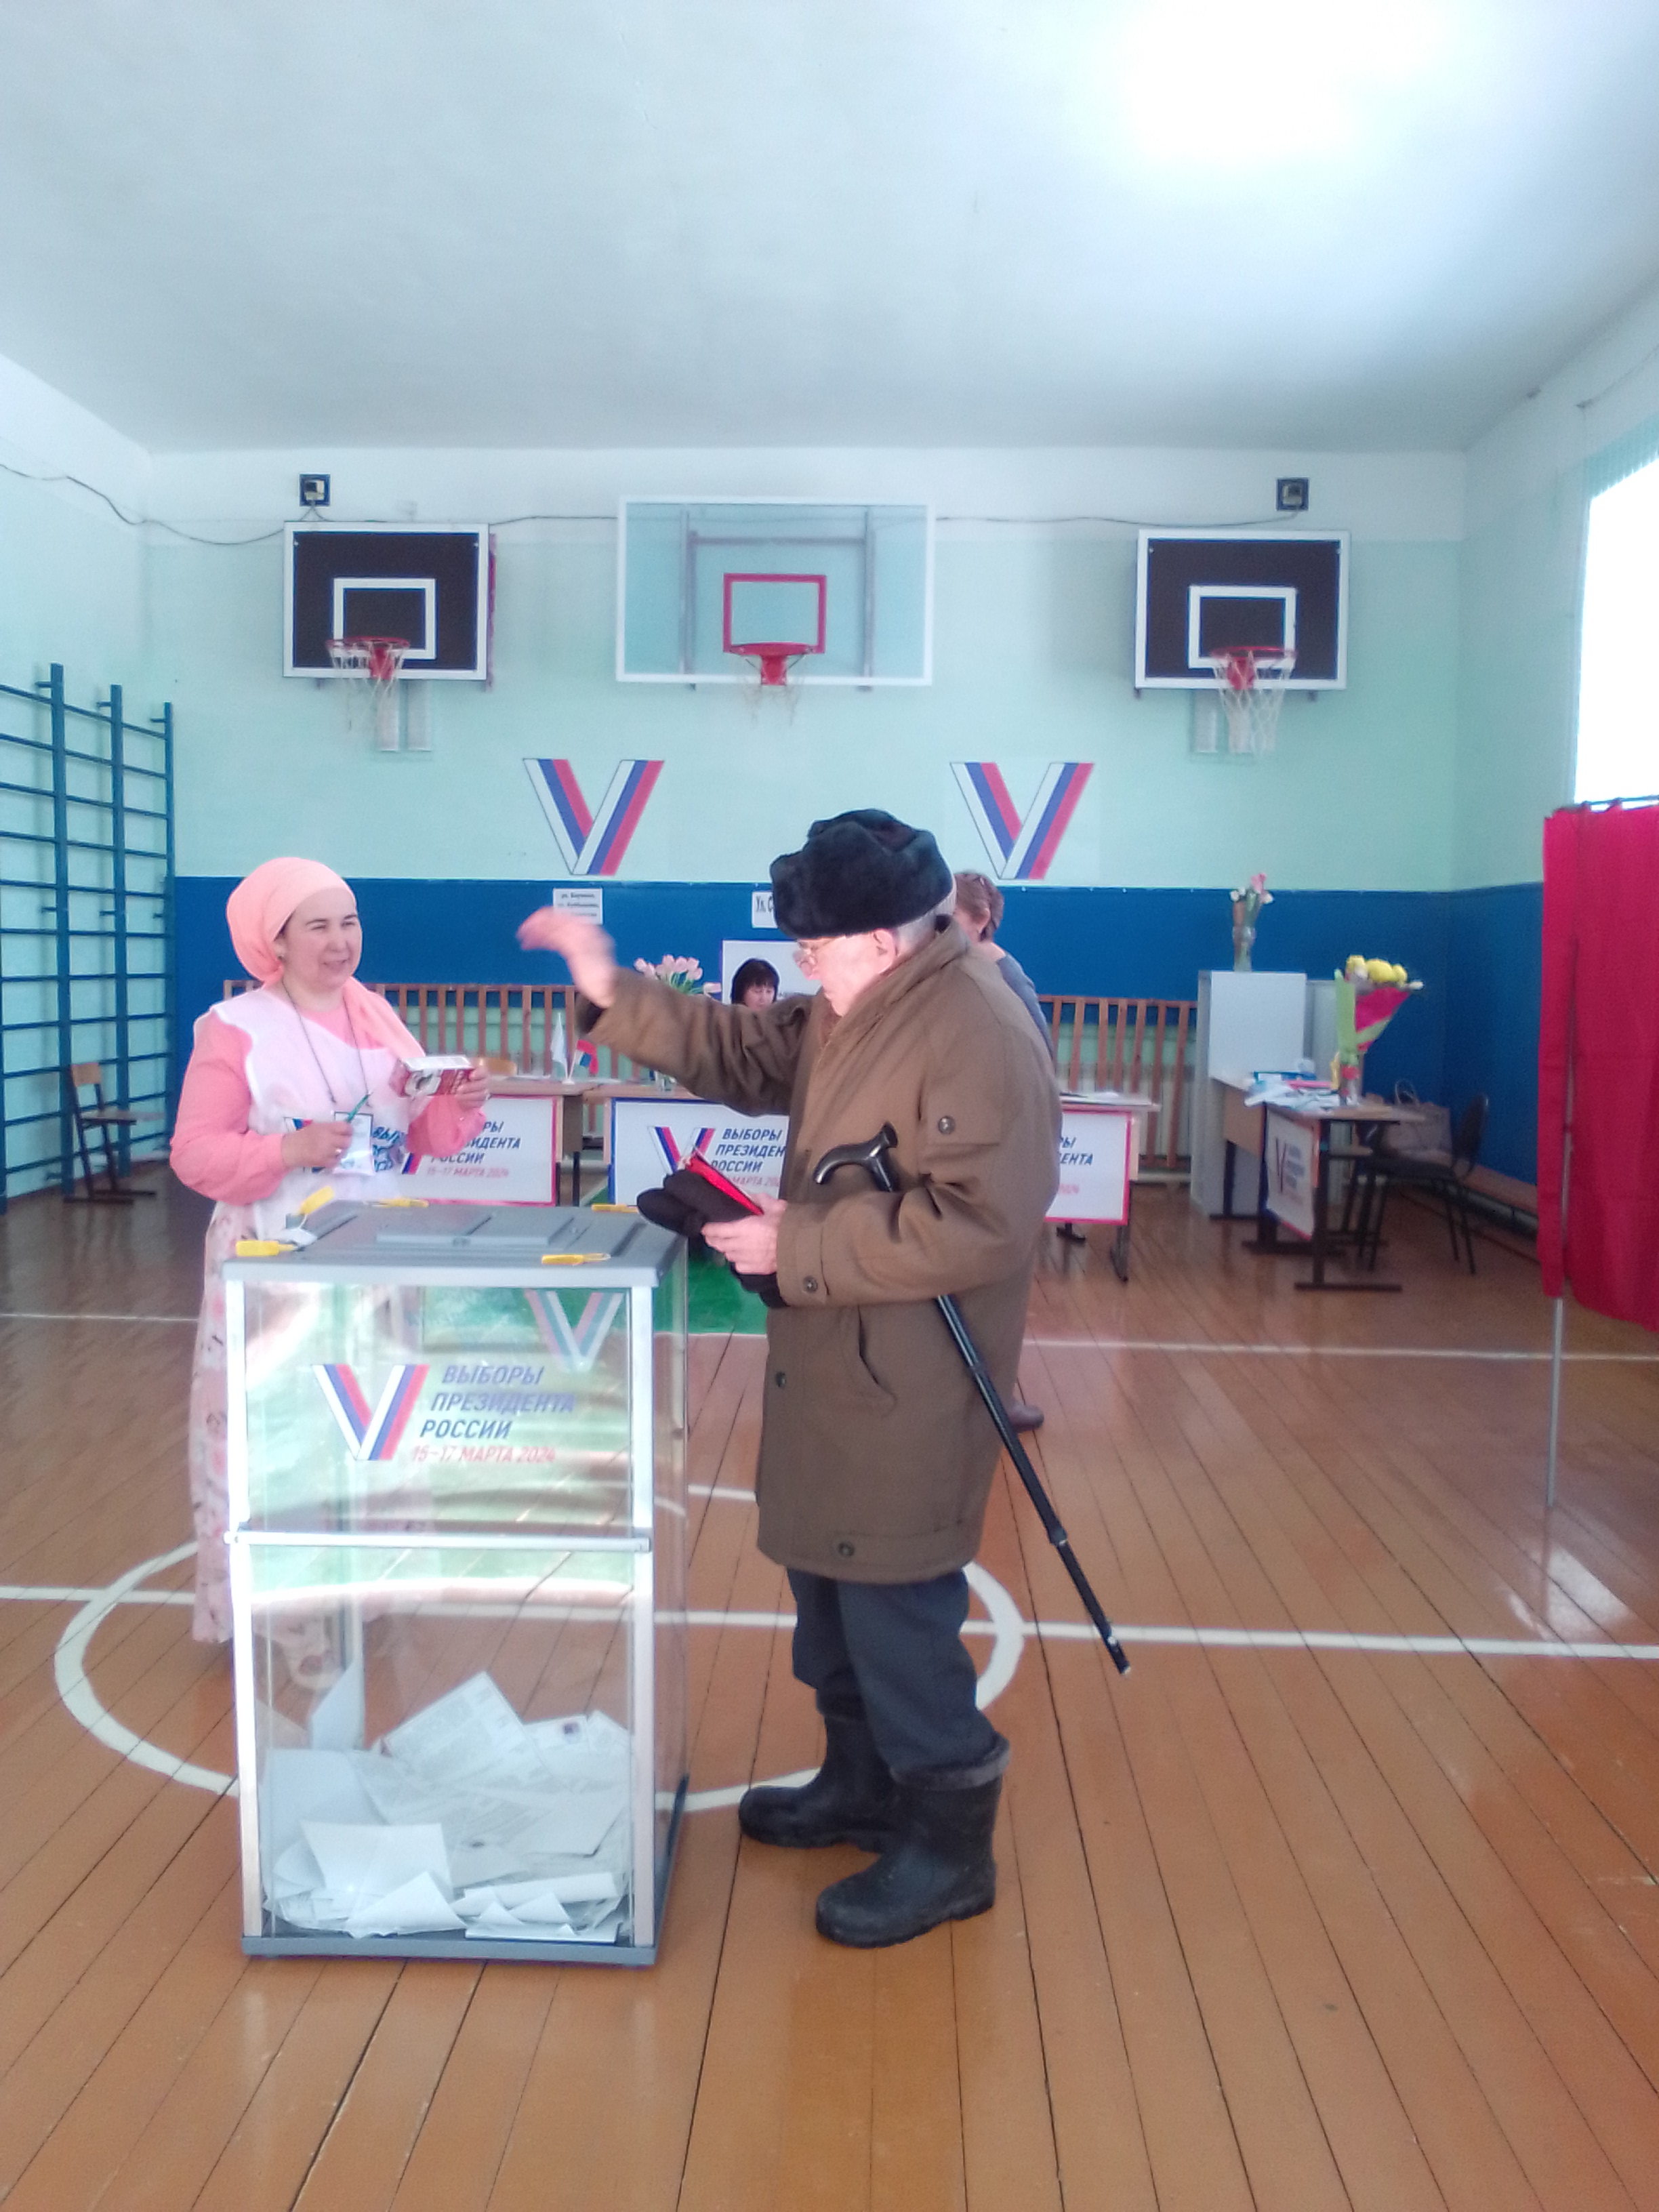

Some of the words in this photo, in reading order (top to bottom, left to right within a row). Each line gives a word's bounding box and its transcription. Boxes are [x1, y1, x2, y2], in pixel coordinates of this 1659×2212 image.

[466, 1137, 521, 1149] ИДЕНТА
[722, 1128, 783, 1141] ВЫБОРЫ
[715, 1143, 786, 1158] ПРЕЗИДЕН
[442, 1365, 545, 1385] ВЫБОРЫ
[430, 1392, 575, 1414] ПРЕЗИДЕНТА
[419, 1418, 514, 1439] РОССИИ
[459, 1445, 514, 1462] МАРТА
[517, 1446, 556, 1464] 2024
